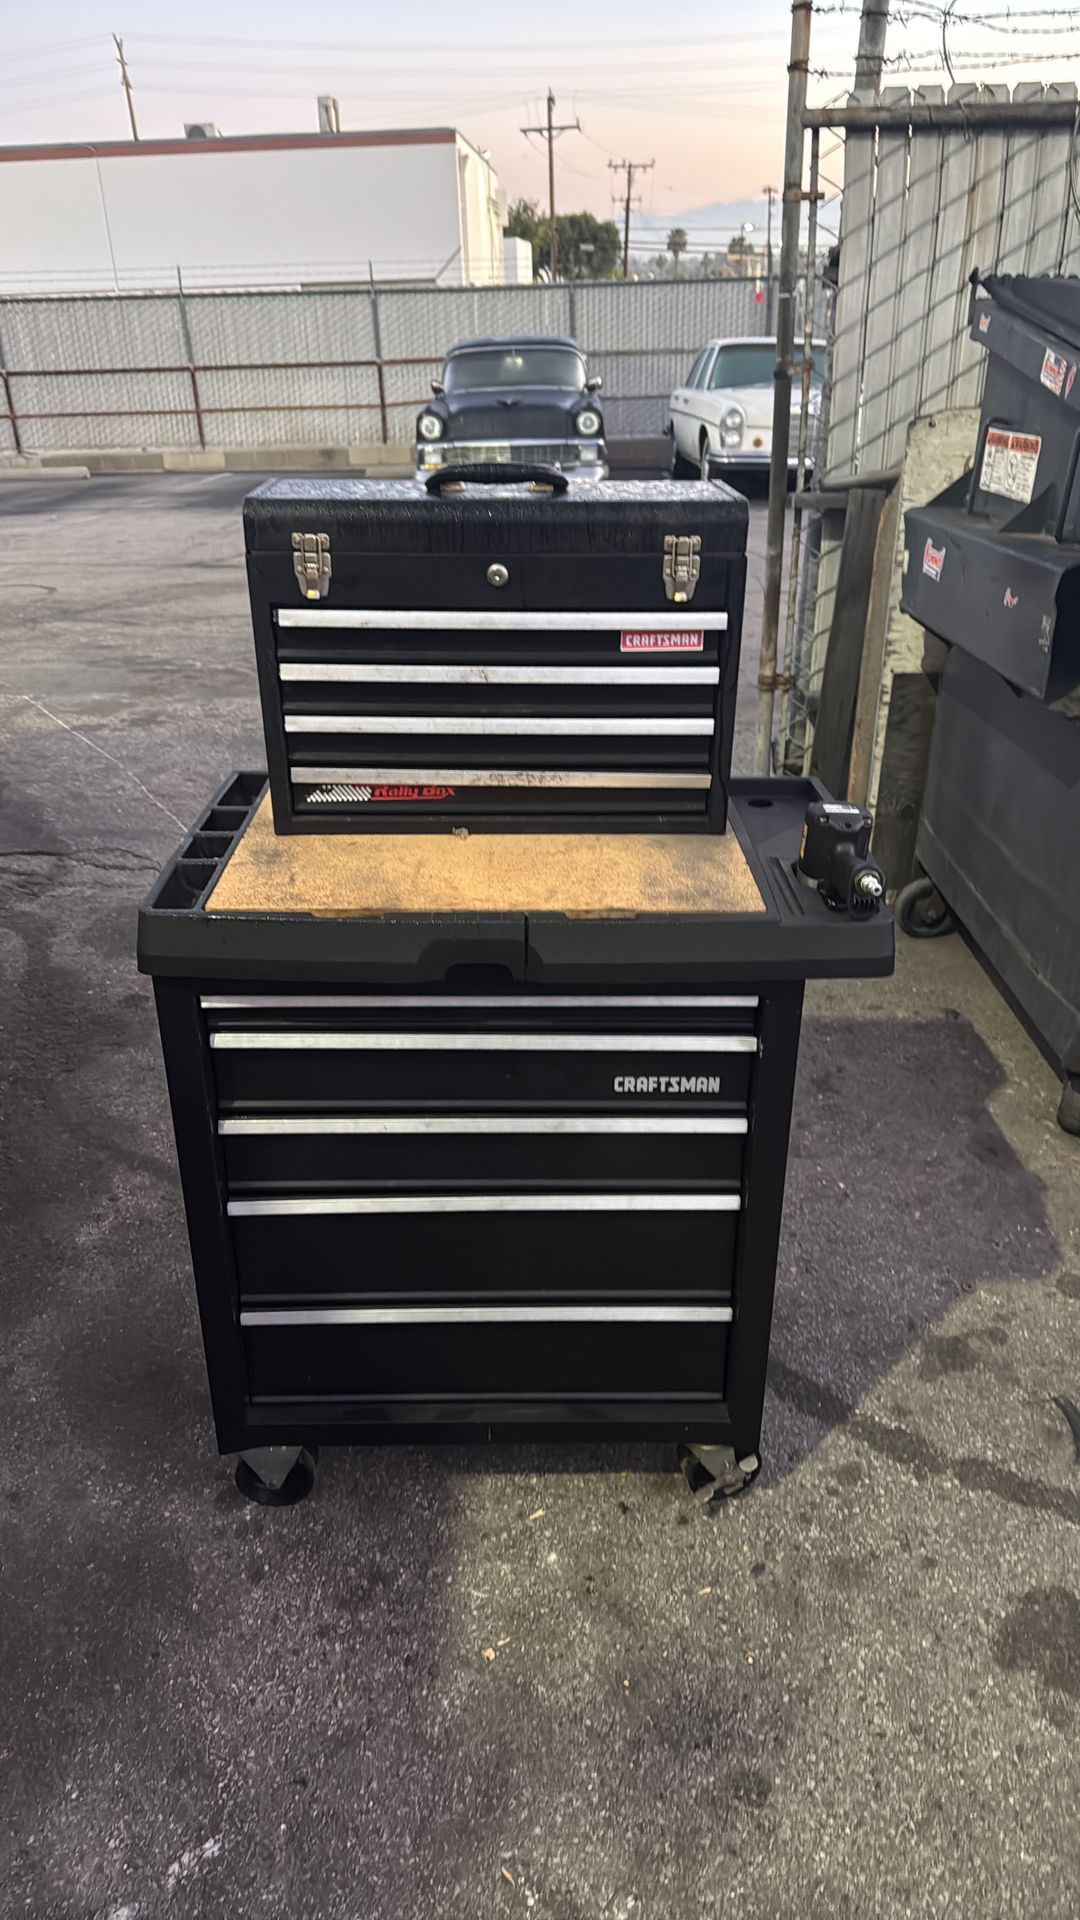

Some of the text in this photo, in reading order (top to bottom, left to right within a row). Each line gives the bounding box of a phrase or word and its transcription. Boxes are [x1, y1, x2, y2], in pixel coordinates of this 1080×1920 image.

[625, 633, 698, 647] CRAFTSMAN
[374, 785, 418, 799] Rally
[614, 1076, 721, 1093] CRAFTSMAN
